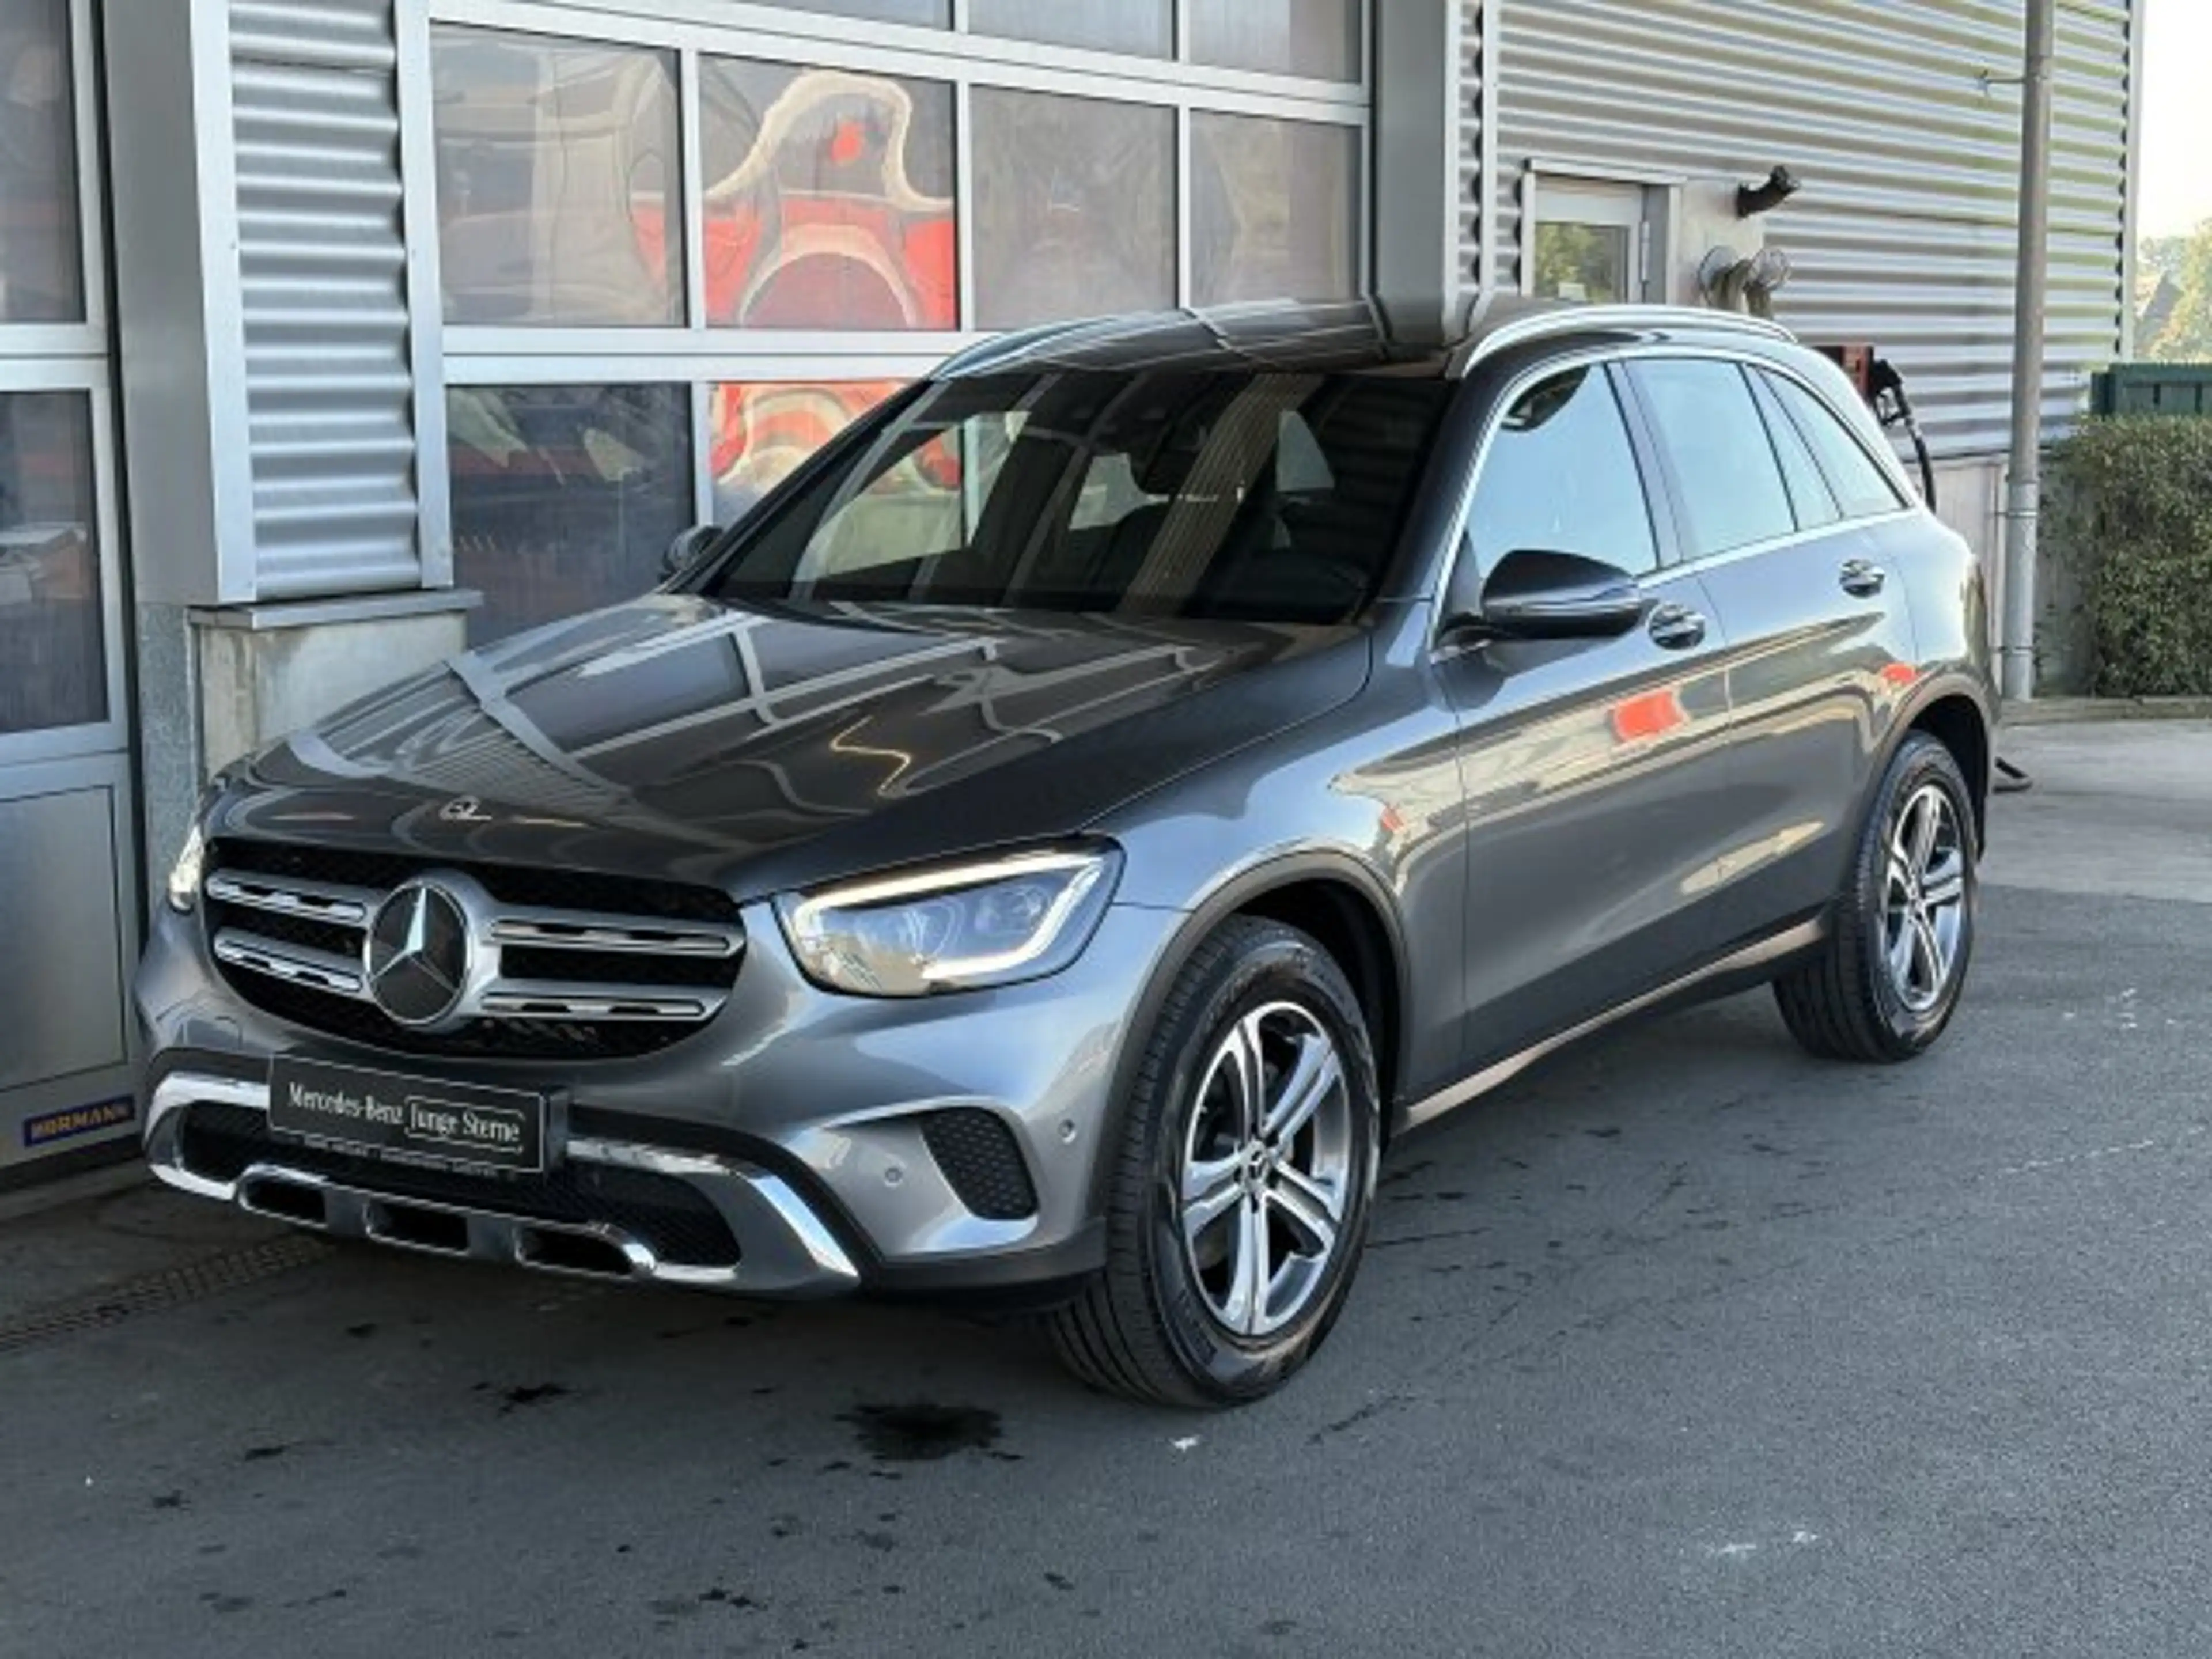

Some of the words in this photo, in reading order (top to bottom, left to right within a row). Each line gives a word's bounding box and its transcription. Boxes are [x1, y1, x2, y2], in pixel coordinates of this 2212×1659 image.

[289, 1081, 403, 1124] Mercedes-Benz
[410, 1101, 457, 1134] Junge
[463, 1111, 520, 1142] Sterne
